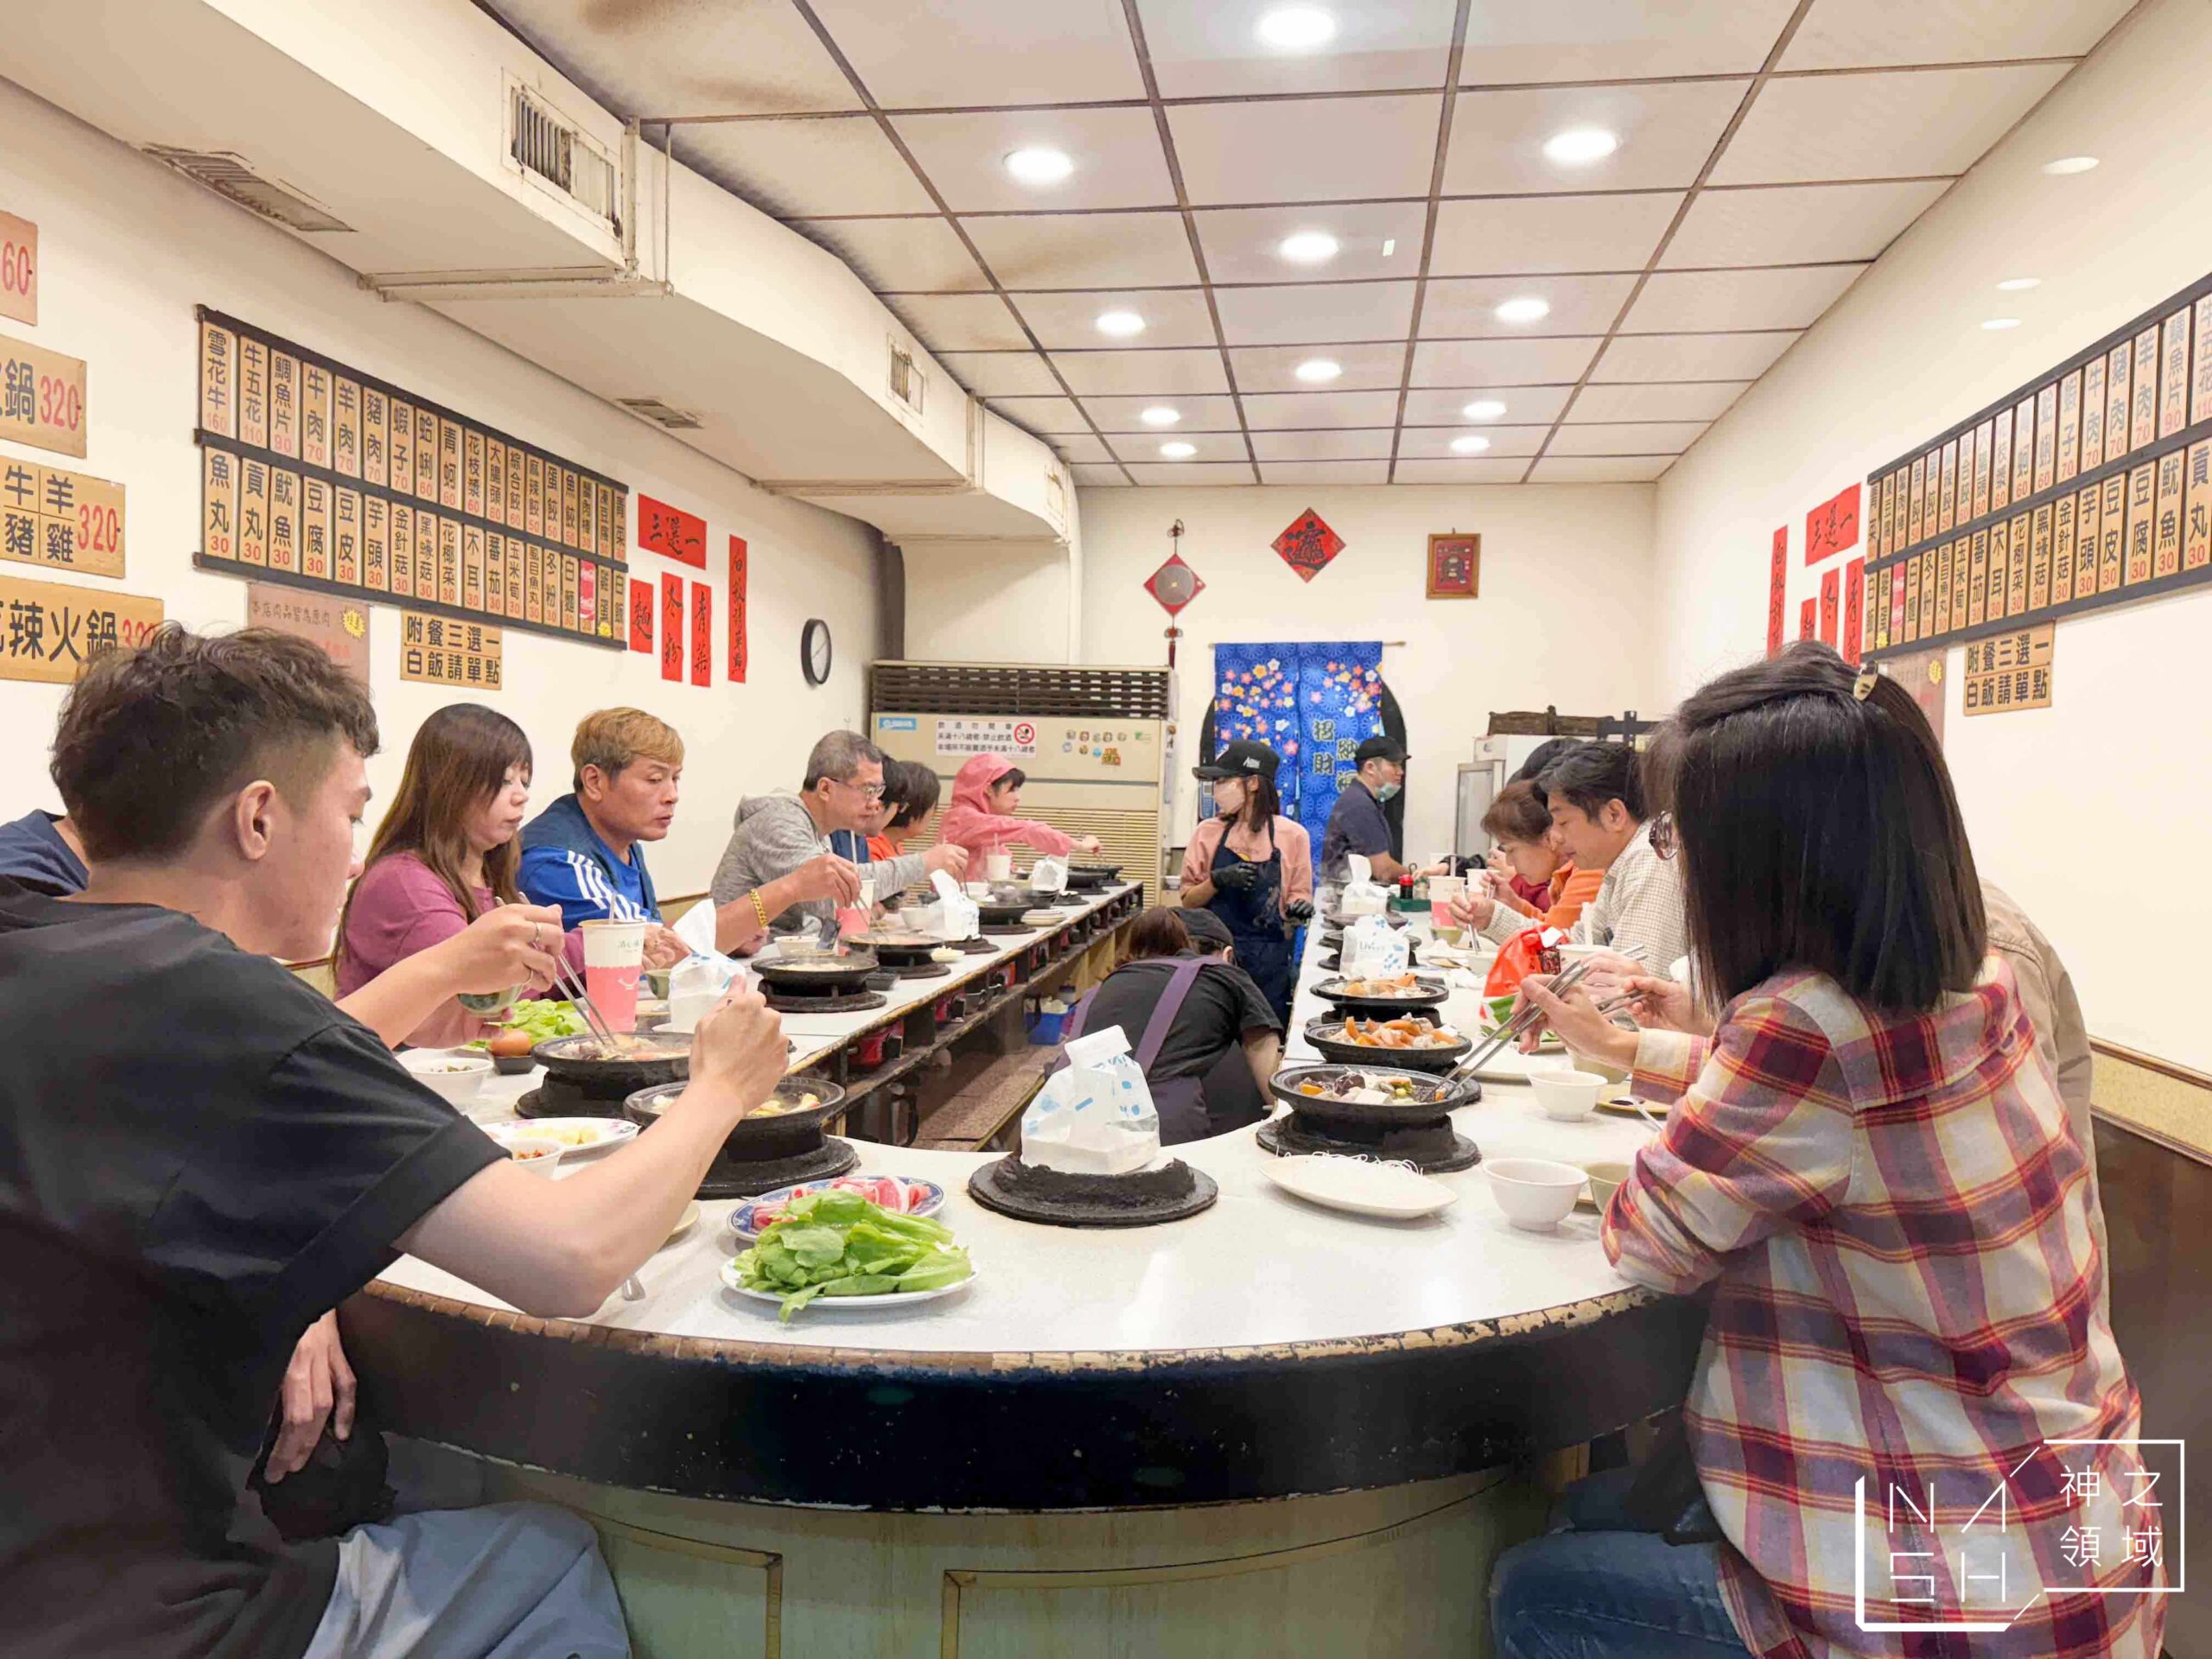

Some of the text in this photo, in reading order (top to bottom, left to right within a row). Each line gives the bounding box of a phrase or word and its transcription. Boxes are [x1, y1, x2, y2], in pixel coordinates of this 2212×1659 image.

[0, 359, 79, 431] 鍋 320
[207, 330, 227, 431] 雪花牛 160
[244, 344, 263, 443] 牛五花 110
[275, 357, 291, 434] 鯛魚片
[308, 369, 324, 461] 牛肉 70
[2086, 365, 2103, 467] 牛肉 70
[2136, 331, 2154, 444] 羊肉 70
[338, 384, 354, 472] 羊肉 70
[366, 394, 382, 482] 豬肉 70
[393, 407, 408, 490] 蝦子 70
[2110, 439, 2123, 455] 70
[2164, 410, 2182, 431] 90
[4, 466, 73, 513] 牛 羊
[209, 454, 230, 553] 魚丸 30
[420, 481, 431, 497] 60
[443, 491, 455, 506] 60
[2016, 482, 2027, 498] 60
[2038, 471, 2050, 487] 60
[2062, 461, 2074, 478] 70
[2189, 446, 2209, 564] 貢丸 30
[5, 513, 73, 563] 豬 雞
[78, 504, 118, 553] 320
[245, 463, 263, 560] 貢丸 30
[273, 473, 292, 565] 魷魚 30
[307, 483, 324, 573] 豆腐 30
[339, 492, 354, 581] 豆皮 30
[468, 499, 480, 513] 60
[2079, 489, 2096, 593] 芋頭 30
[2103, 479, 2120, 585] 豆皮 30
[2132, 468, 2151, 579] 豆腐 30
[2159, 458, 2178, 572] 魷魚 30
[368, 500, 384, 586] 芋頭 30
[395, 509, 408, 592] 金針菇 30
[467, 532, 479, 606] 木耳 30
[1990, 527, 2004, 617] 木耳 30
[2056, 500, 2071, 600] 金針菇 30
[420, 584, 431, 598] 30
[443, 588, 454, 603] 30
[490, 598, 500, 611] 30
[510, 601, 519, 614] 30
[530, 607, 539, 619] 30
[547, 610, 556, 622] 30
[2012, 595, 2023, 611] 30
[2033, 589, 2044, 605] 30
[0, 599, 118, 661] 辣火鍋
[407, 616, 499, 652] 附餐三選一
[407, 648, 499, 683] 白飯請單點
[1967, 634, 2050, 673] 附餐三選一
[1967, 669, 2048, 707] 白飯請單點
